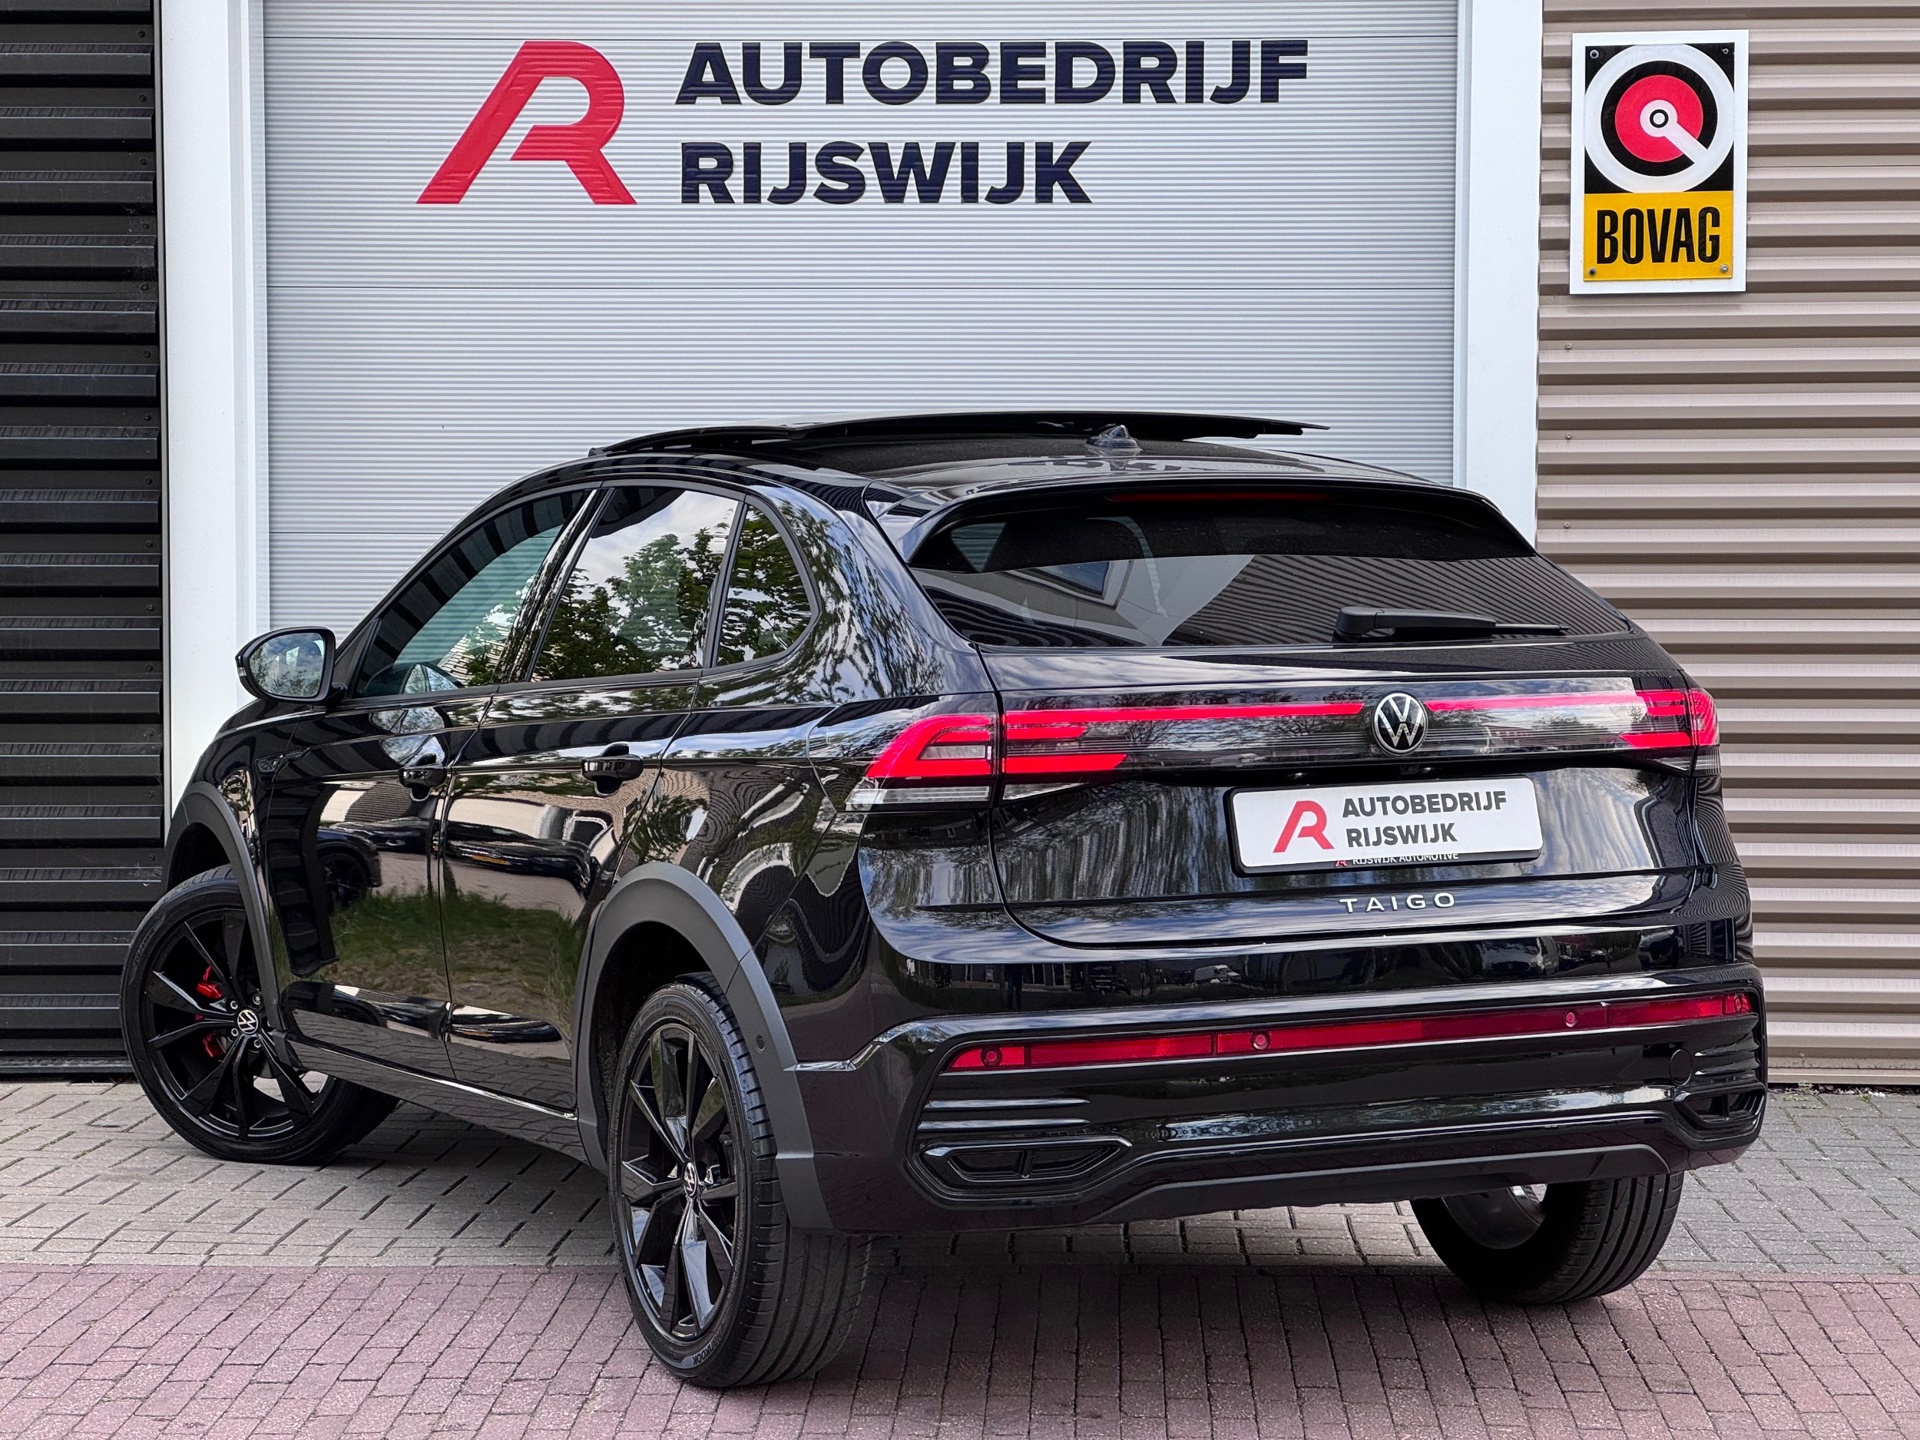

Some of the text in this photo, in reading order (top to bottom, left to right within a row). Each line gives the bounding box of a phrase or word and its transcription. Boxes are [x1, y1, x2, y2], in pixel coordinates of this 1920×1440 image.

[675, 40, 1309, 105] AUTOBEDRIJF
[680, 141, 1093, 205] RIJSWIJK
[1596, 206, 1721, 265] BOVAG
[1342, 790, 1508, 819] AUTOBEDRIJF
[1346, 822, 1458, 848] RIJSWIJK
[1338, 891, 1456, 914] TAIGO
